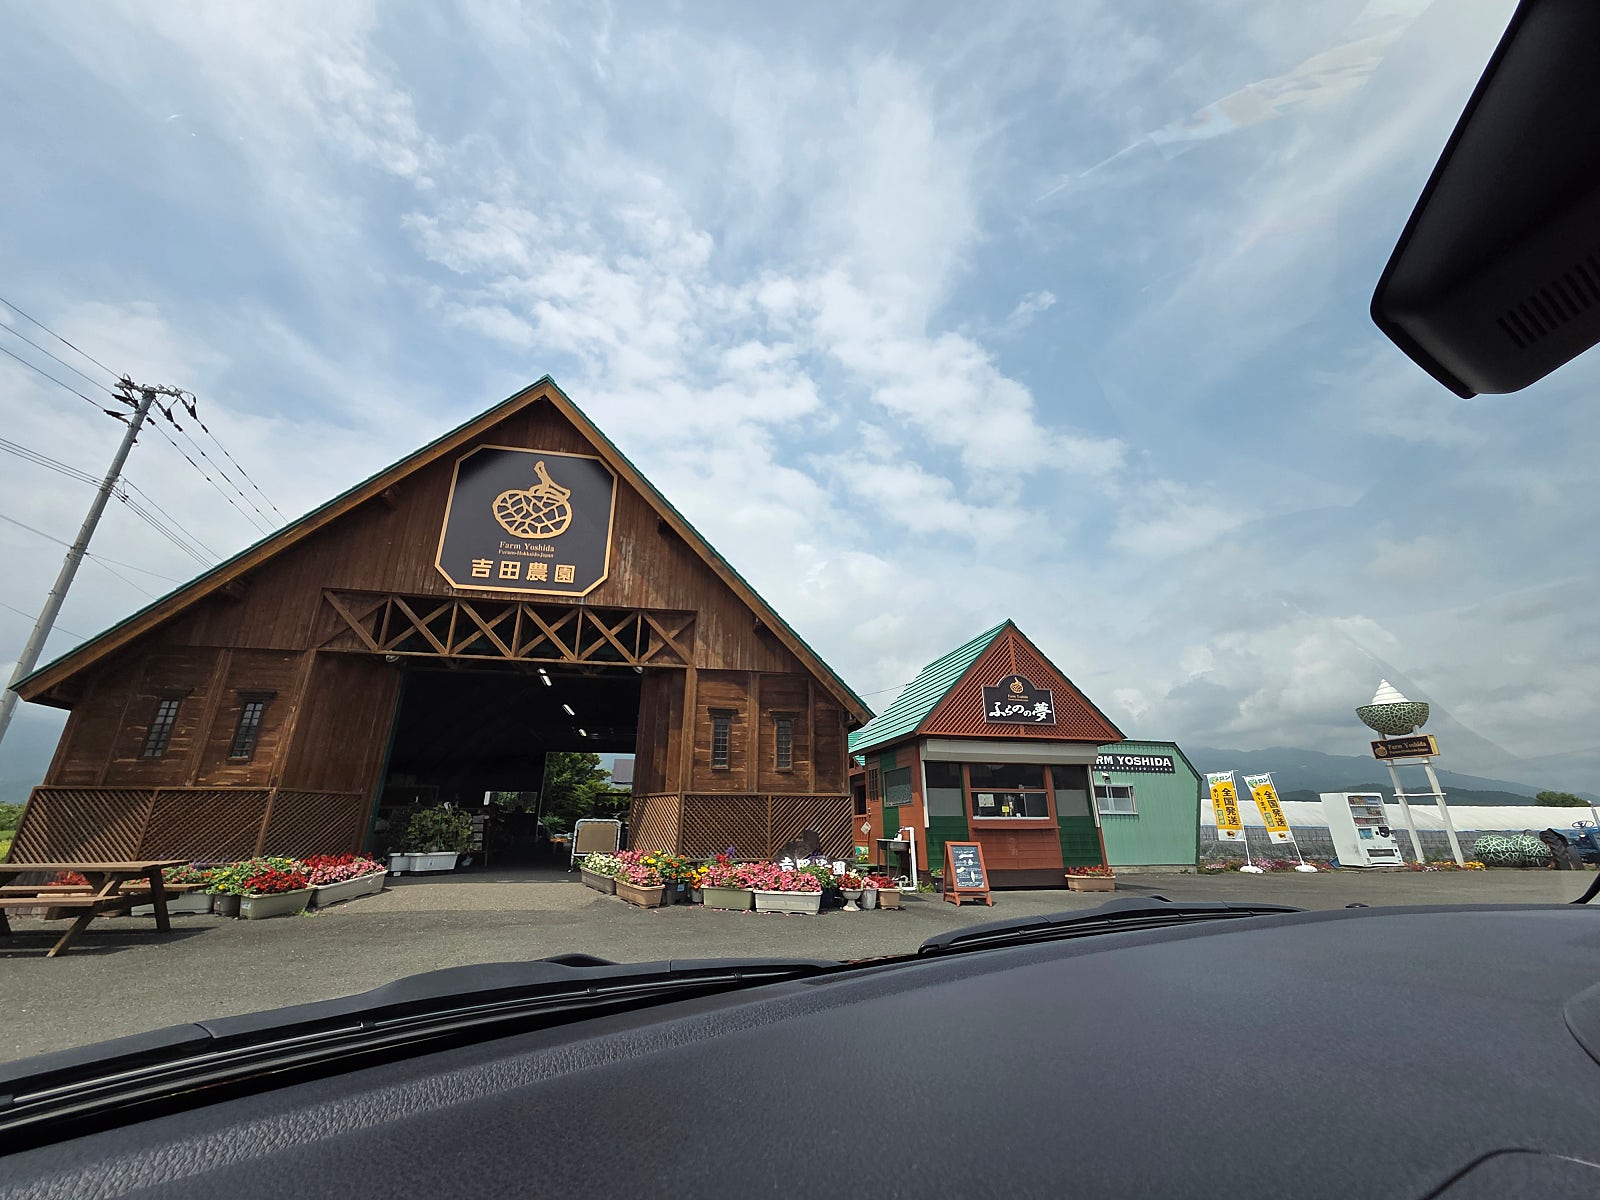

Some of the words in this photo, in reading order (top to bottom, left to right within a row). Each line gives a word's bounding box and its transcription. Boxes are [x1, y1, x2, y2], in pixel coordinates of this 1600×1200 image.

[500, 541, 521, 549] Farm
[524, 542, 555, 552] Yoshida
[471, 559, 576, 583] 吉田農園
[1095, 755, 1114, 765] RM
[1116, 756, 1172, 767] YOSHIDA
[1222, 787, 1239, 826] 全国発送
[1263, 790, 1287, 827] 全国発送
